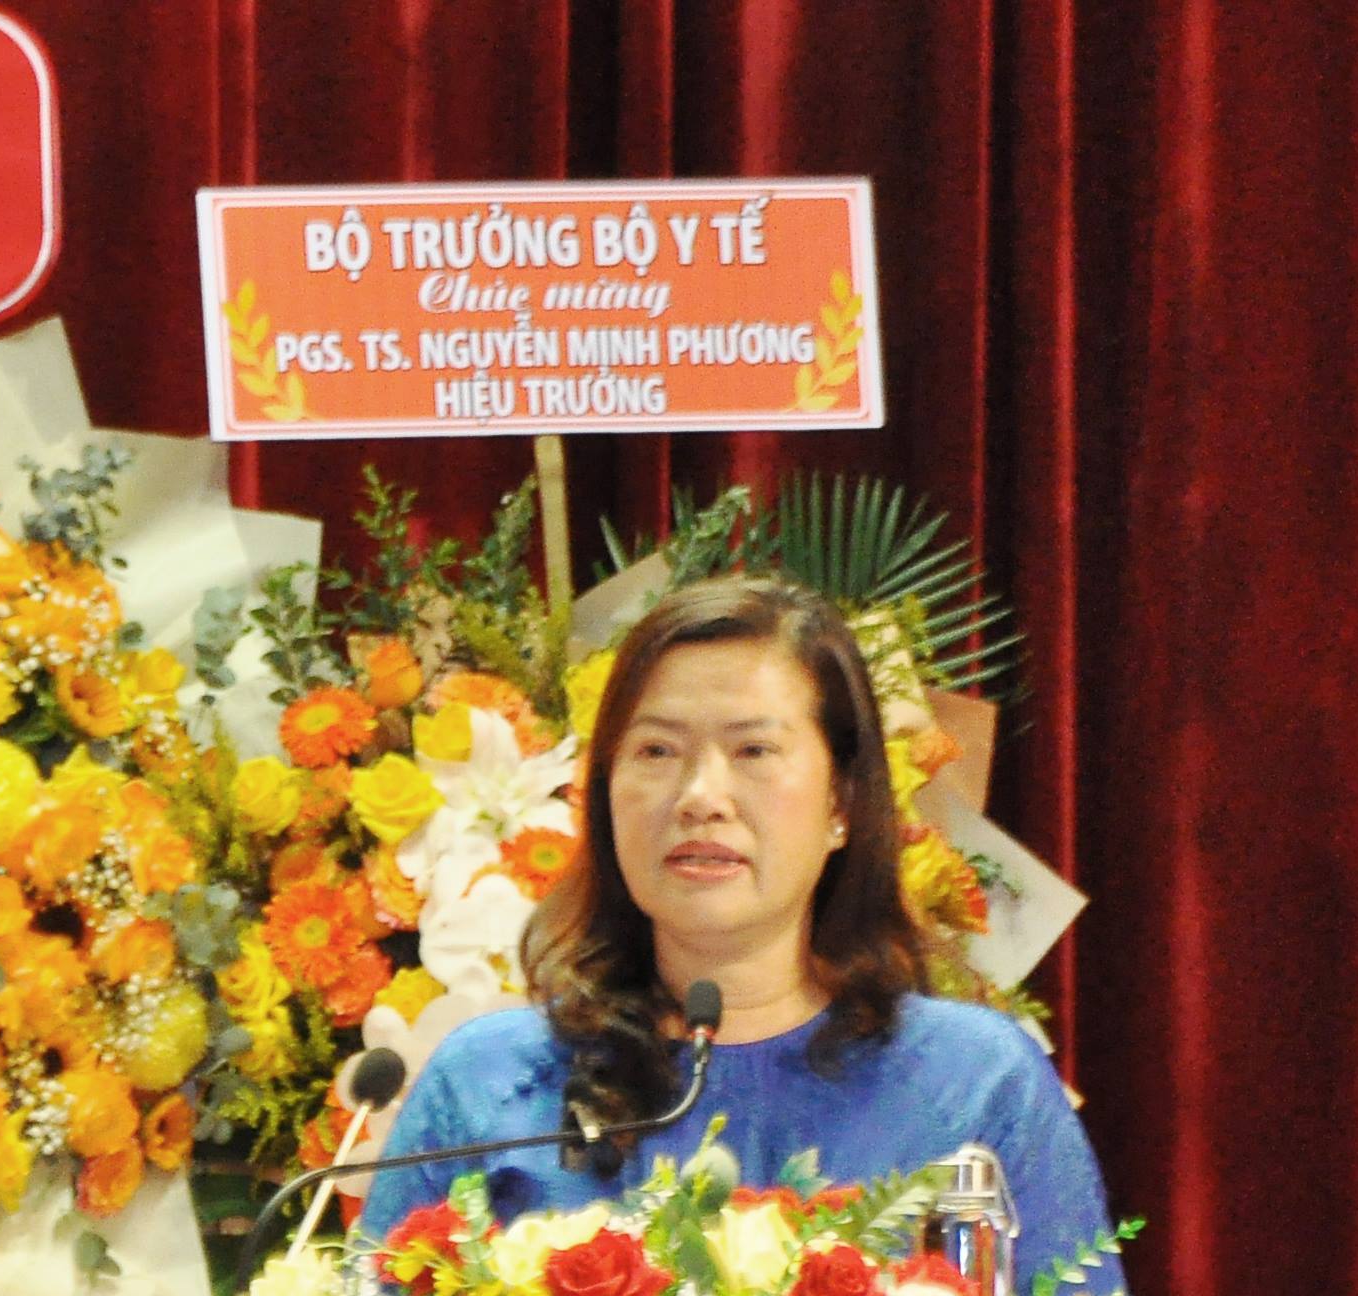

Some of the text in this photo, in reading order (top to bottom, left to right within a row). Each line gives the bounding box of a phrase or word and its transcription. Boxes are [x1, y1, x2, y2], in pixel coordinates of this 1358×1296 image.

[304, 194, 771, 283] BỘ TRƯỞNG BỘ Y TẾ
[417, 270, 671, 319] Chúc mừng
[274, 309, 816, 374] PGS. TS. NGUYỄN MINH PHƯƠNG
[434, 365, 667, 426] HIỆU TRƯỞNG
